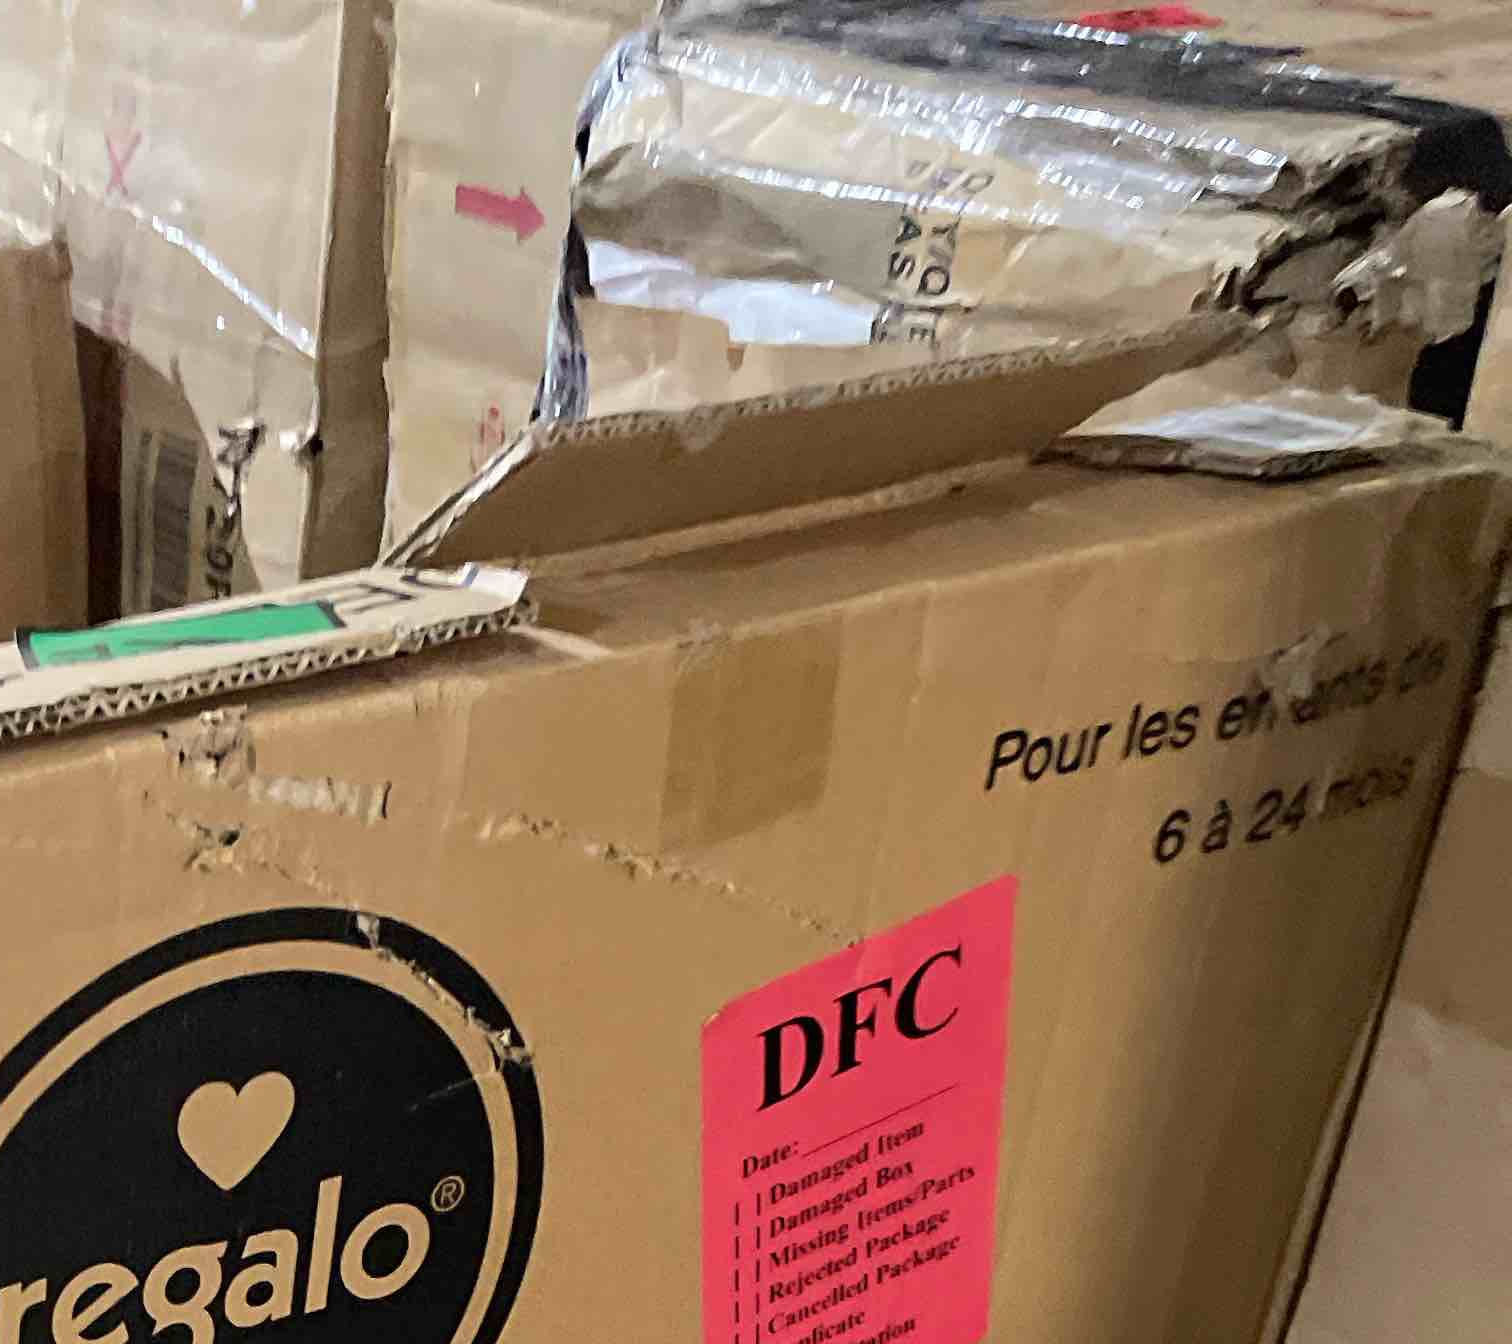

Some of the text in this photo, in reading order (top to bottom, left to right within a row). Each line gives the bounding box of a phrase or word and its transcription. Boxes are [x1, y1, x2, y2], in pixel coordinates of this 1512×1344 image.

[984, 721, 1113, 791] Pour
[1123, 703, 1200, 761] les
[1153, 809, 1191, 865] 6
[1200, 800, 1234, 856] à
[1245, 781, 1313, 846] 24
[755, 943, 963, 1113] DFC
[742, 1140, 799, 1179] Date:
[769, 1121, 924, 1204] Damaged Item
[769, 1161, 914, 1238] Damaged Box
[768, 1236, 960, 1334] Cancelled Package
[769, 1223, 849, 1268] Missing
[769, 1209, 950, 1303] Rejected Package
